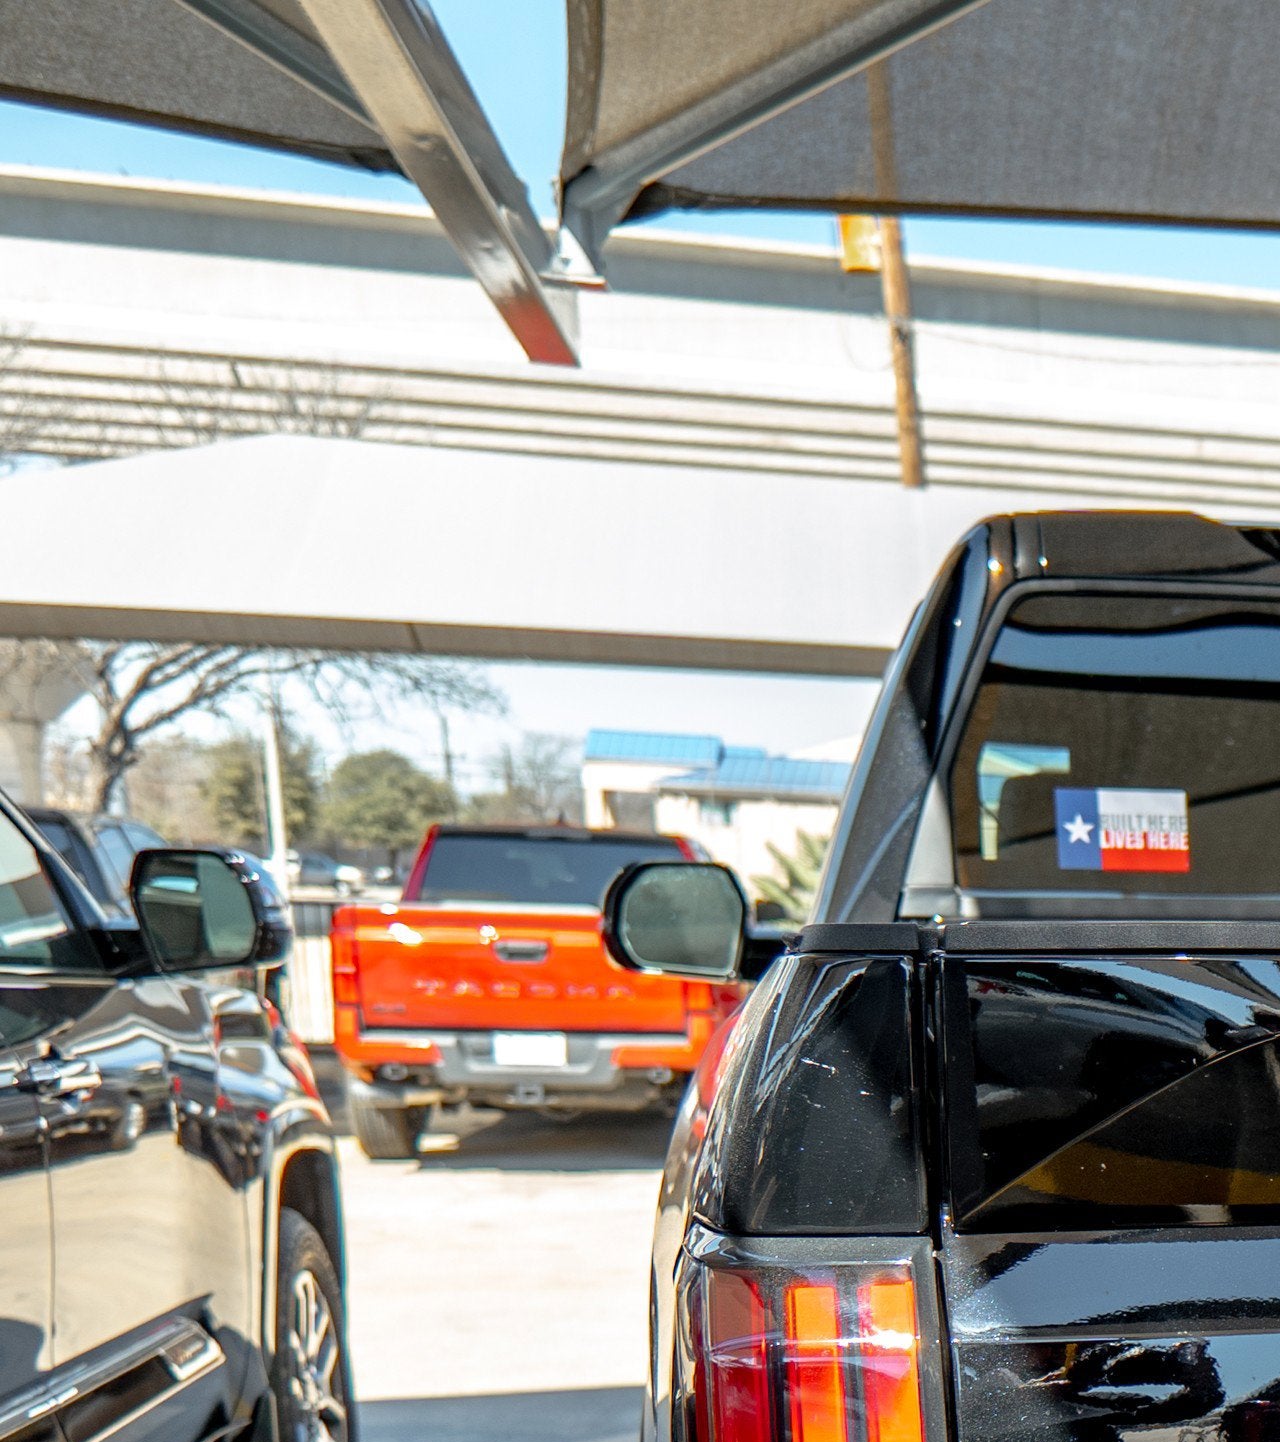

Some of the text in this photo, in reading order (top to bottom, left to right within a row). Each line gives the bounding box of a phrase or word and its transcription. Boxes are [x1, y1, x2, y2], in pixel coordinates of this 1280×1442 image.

[1100, 813, 1188, 833] BUILT HERE
[1100, 830, 1189, 851] LIVES HERE
